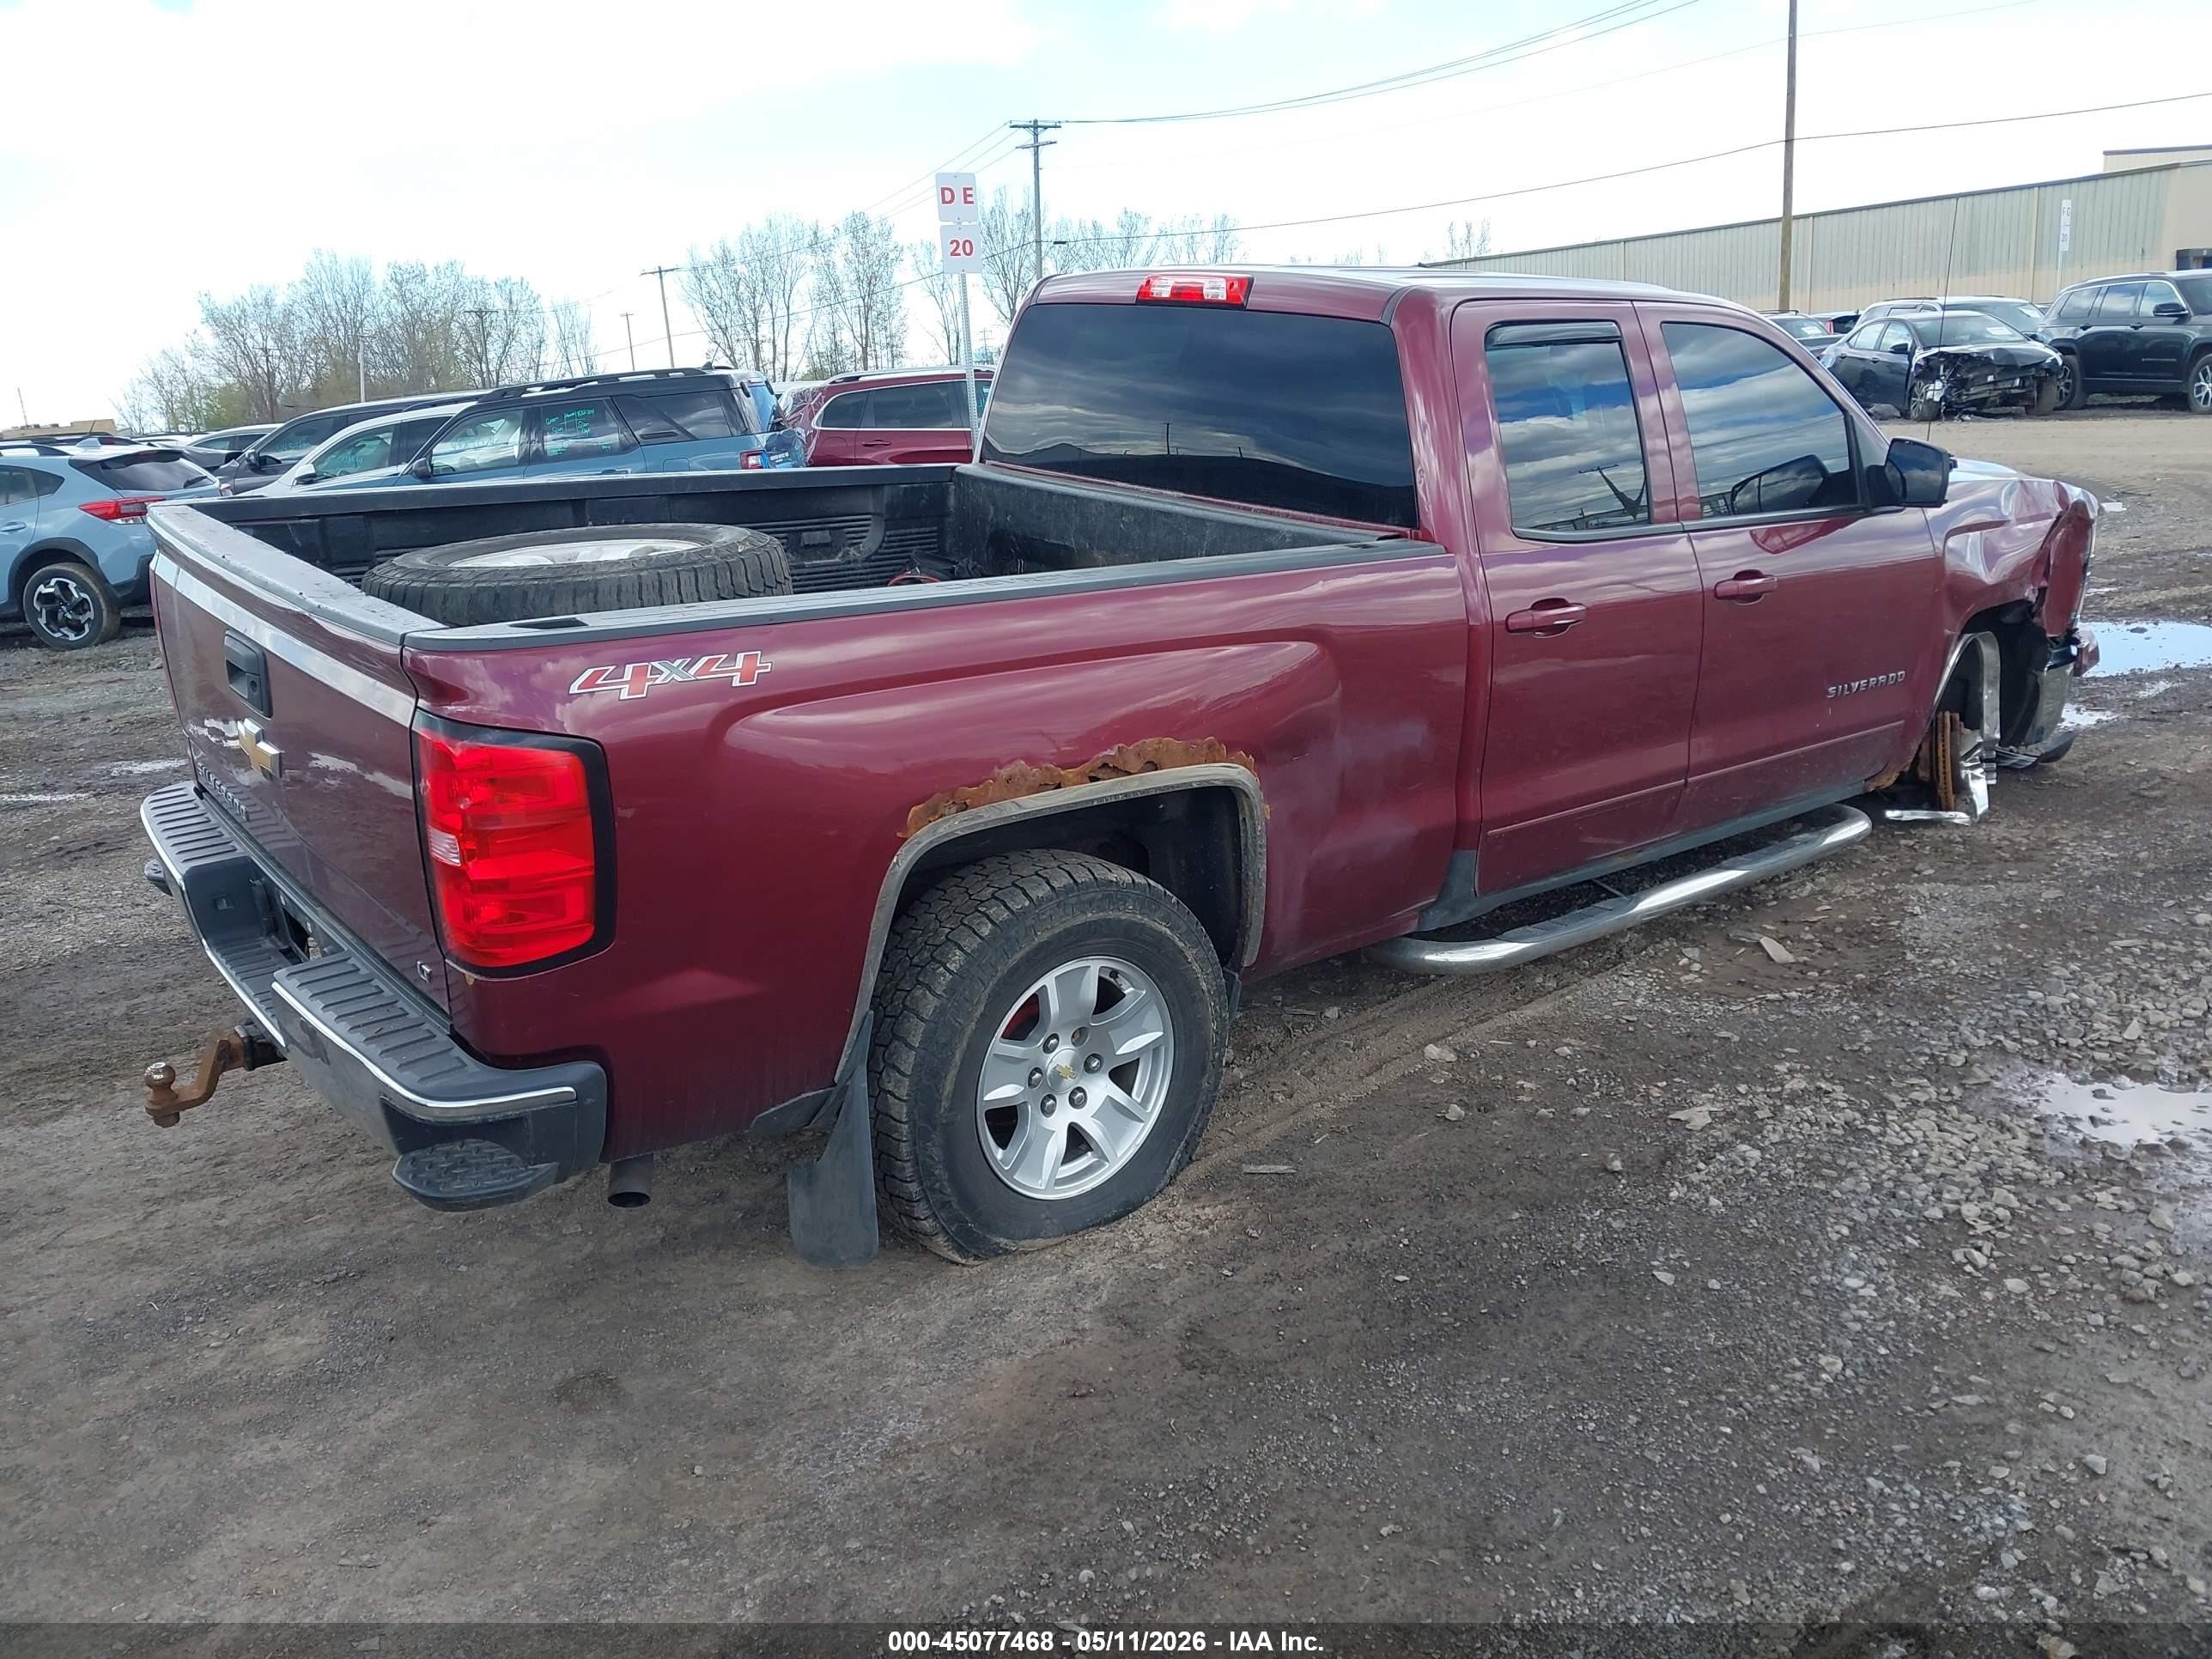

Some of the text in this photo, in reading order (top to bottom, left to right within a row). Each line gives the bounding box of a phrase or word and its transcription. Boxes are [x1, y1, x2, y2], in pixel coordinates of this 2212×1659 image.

[940, 186, 975, 204] D E
[949, 239, 974, 257] 20
[1826, 670, 1906, 698] SILVERADO
[416, 961, 432, 982] LT
